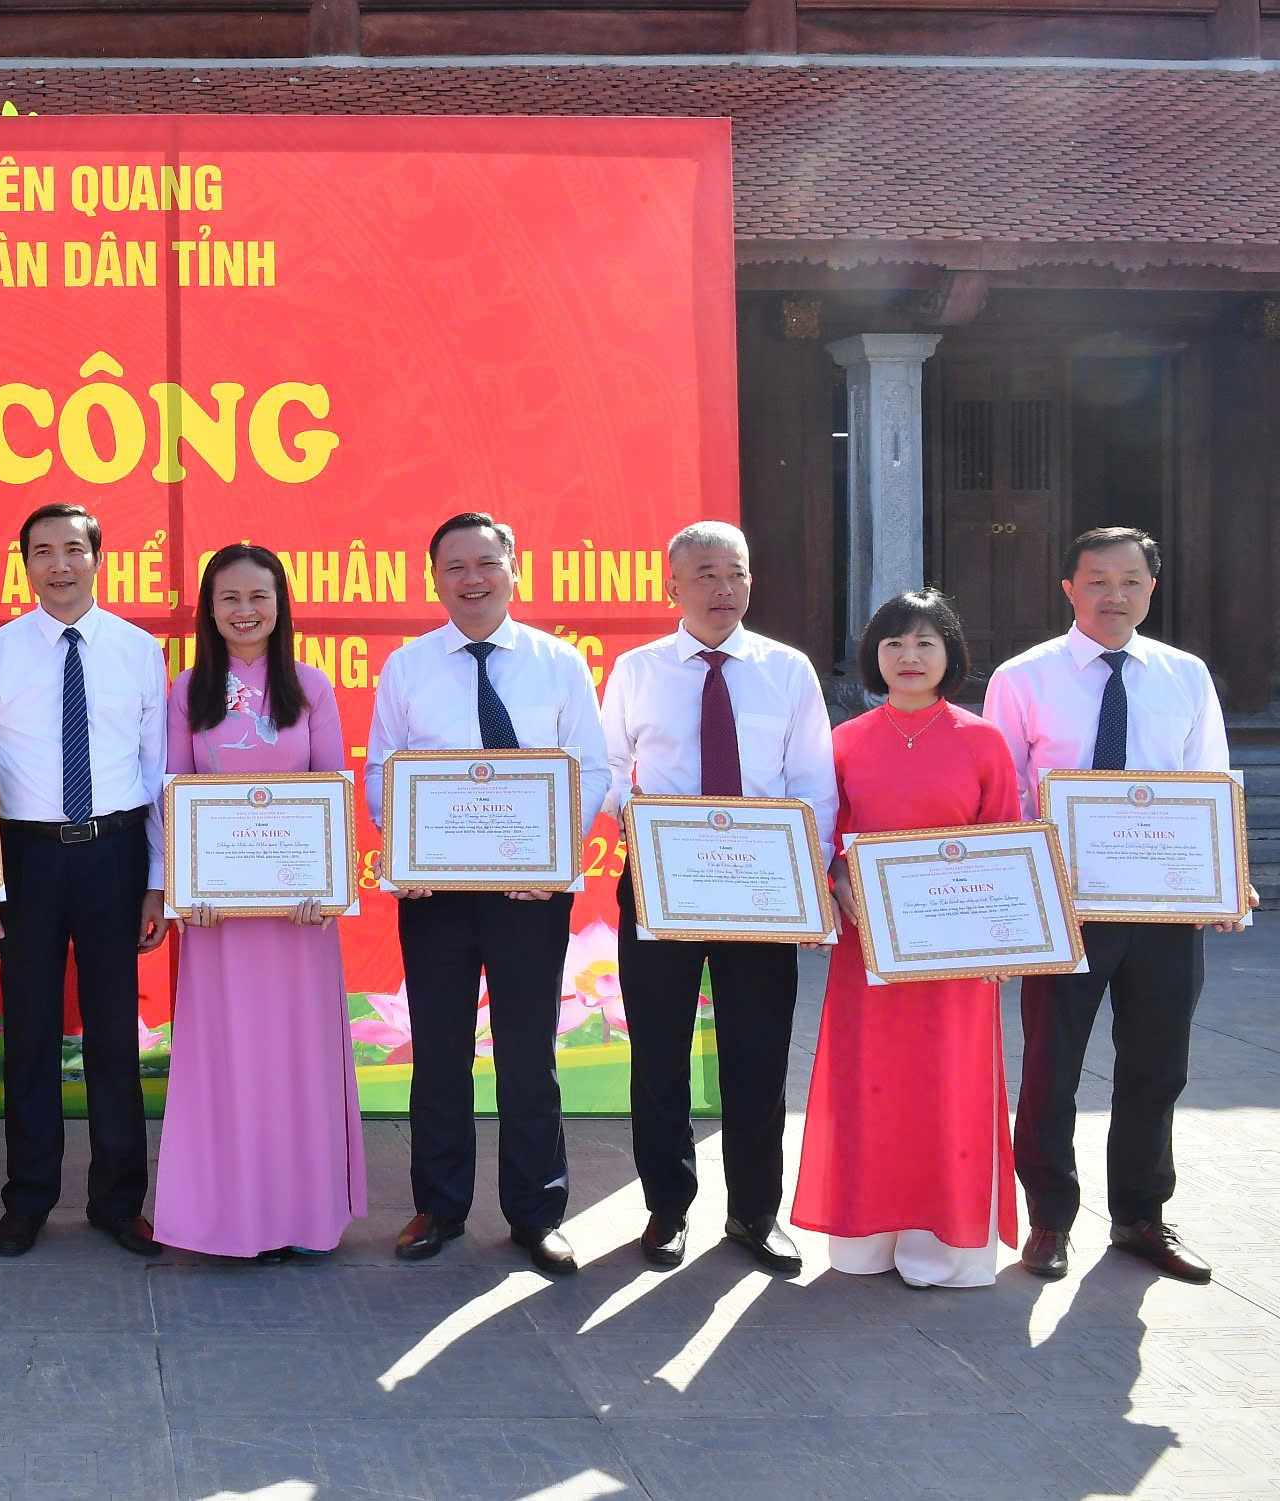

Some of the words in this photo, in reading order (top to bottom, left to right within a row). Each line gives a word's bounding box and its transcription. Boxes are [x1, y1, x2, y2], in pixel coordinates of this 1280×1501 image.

[71, 165, 222, 217] QUANG
[64, 231, 157, 287] DÂN
[172, 225, 275, 287] TỈNH
[276, 539, 406, 602] NHÂN
[482, 804, 513, 812] KHEN
[261, 829, 291, 837] KHEN
[1144, 830, 1176, 839] KHEN
[727, 852, 757, 861] KHEN
[961, 883, 995, 894] KHEN
